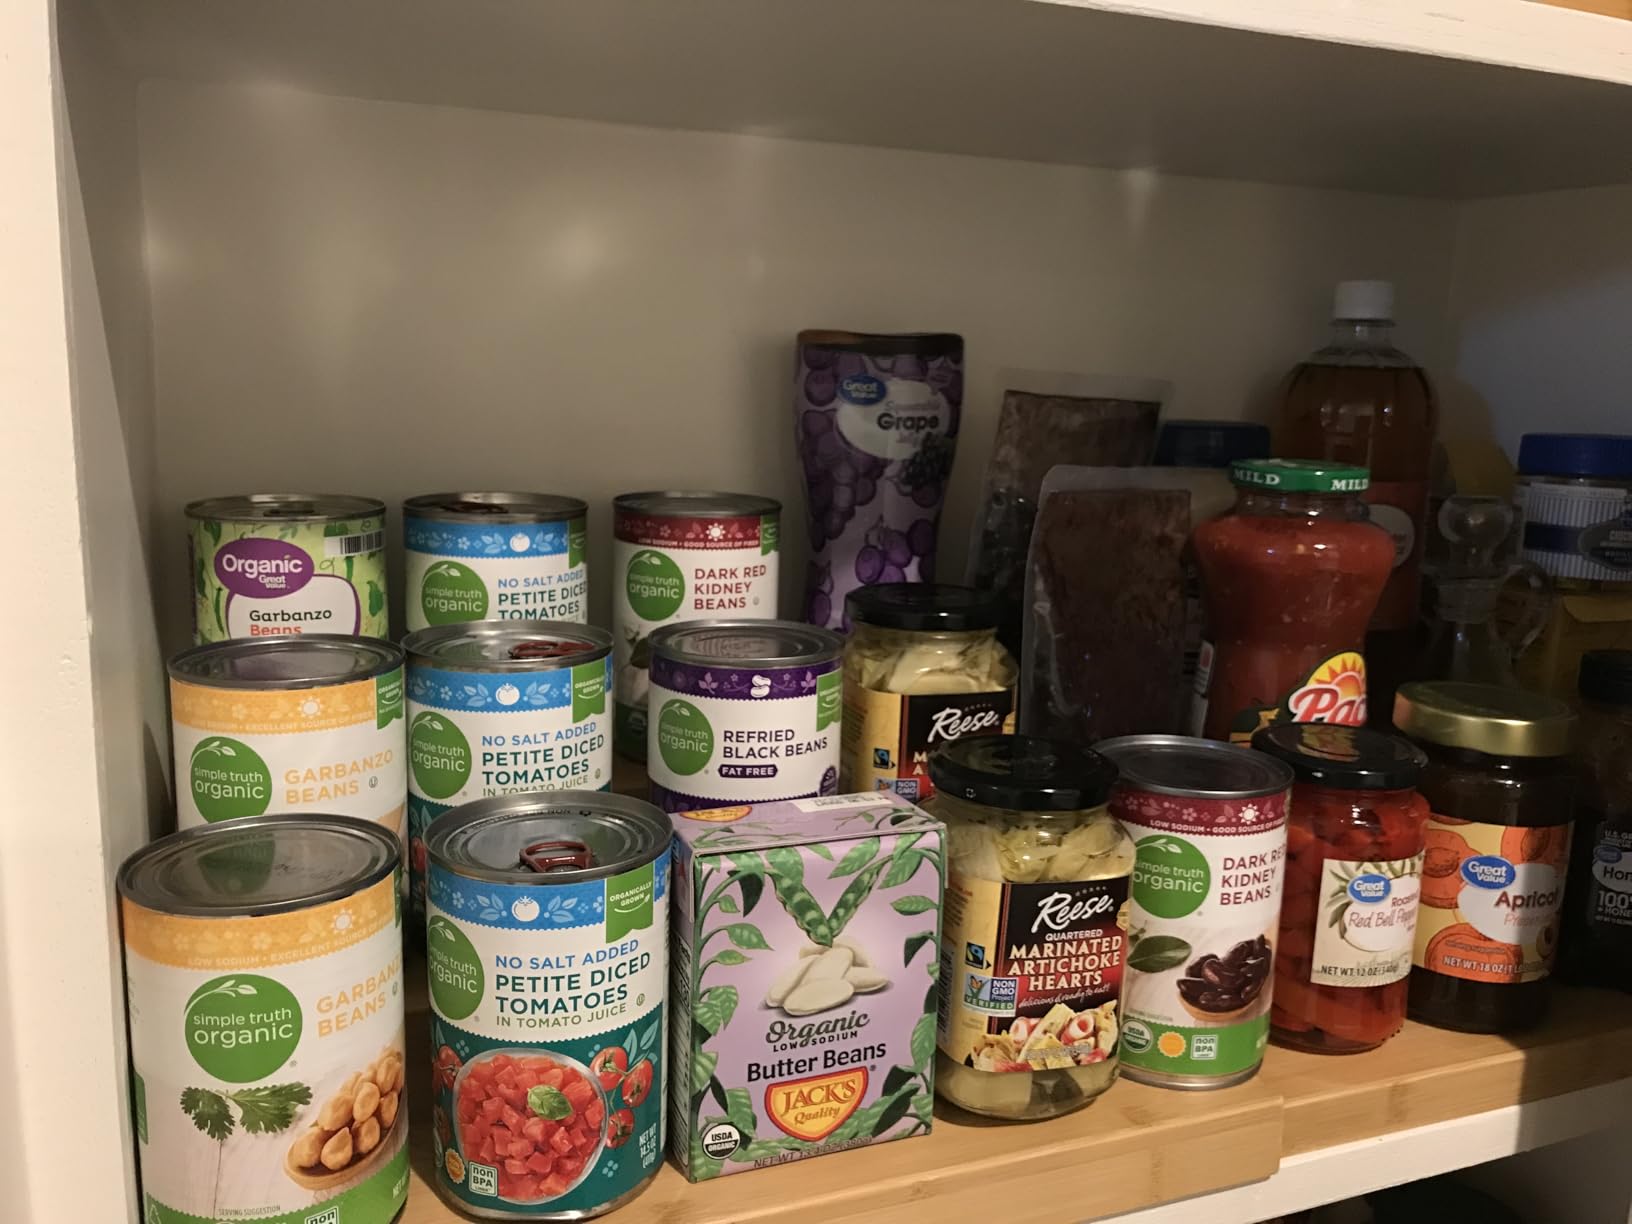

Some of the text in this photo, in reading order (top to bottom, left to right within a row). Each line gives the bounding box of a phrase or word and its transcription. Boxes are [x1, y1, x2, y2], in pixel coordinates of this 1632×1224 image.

[877, 412, 939, 434] Grape
[1234, 469, 1280, 485] MILD
[1331, 478, 1369, 491] MILD
[222, 554, 303, 578] Organic
[695, 564, 767, 580] DARK RED
[498, 578, 519, 588] NO
[524, 576, 553, 587] SALT
[656, 575, 680, 586] truth
[694, 581, 752, 595] KIDNEY
[455, 588, 482, 599] truth
[498, 590, 557, 606] PETITE
[629, 583, 680, 599] organic
[425, 596, 483, 613] organic
[498, 600, 580, 620] TOMATOES
[694, 596, 747, 611] BEANS
[249, 608, 332, 622] Garbanzo
[250, 624, 302, 636] Beans
[685, 728, 708, 739] truth
[927, 706, 998, 743] Reese
[482, 722, 596, 746] NO SALT ADDED
[661, 732, 708, 753] organic
[723, 729, 795, 743] REFRIED
[437, 744, 465, 757] truth
[482, 734, 605, 767] PETITE DICED
[723, 737, 828, 759] BLACK BEANS
[284, 749, 393, 785] GARBANZO
[413, 749, 465, 773] organic
[194, 766, 263, 783] simple truth
[482, 759, 590, 785] TOMATOES
[722, 766, 774, 775] FAT FREE
[195, 781, 264, 799] organic
[285, 780, 359, 804] BEANS
[483, 787, 497, 797] IN
[559, 775, 589, 791] JUICE
[896, 787, 917, 795] GMO
[1150, 819, 1170, 827] LOW
[1171, 822, 1205, 833] SODIUM
[1212, 826, 1236, 834] GOOD
[1238, 824, 1265, 833] SOURCE
[1223, 852, 1267, 870] DARK
[1468, 861, 1507, 876] Great
[1132, 870, 1204, 893] organic
[1173, 867, 1204, 878] truth
[1221, 867, 1277, 888] KIDNEY
[1476, 873, 1506, 883] Value
[609, 881, 652, 902] ORGANICALLY
[1354, 880, 1385, 891] Great
[620, 892, 645, 906] GROWN
[1220, 885, 1271, 905] BEANS
[1031, 891, 1113, 933] Reese
[1348, 909, 1394, 928] Red Bell
[1045, 929, 1103, 942] QUARTERED
[495, 939, 639, 970] NO SALT ADDED
[1008, 936, 1122, 959] MARINATED
[450, 957, 477, 976] truth
[495, 952, 651, 993] PETITE DICED
[1007, 951, 1121, 976] ARTICHOKE
[1320, 965, 1338, 975] NET
[1356, 967, 1366, 976] 12
[1443, 955, 1461, 967] NET
[1463, 959, 1477, 970] WT
[1480, 962, 1490, 972] 18
[1492, 964, 1504, 973] OZ
[430, 955, 477, 993] organic
[1028, 970, 1103, 992] HEARTS
[992, 979, 1015, 988] NON
[992, 987, 1015, 996] GMO
[495, 984, 629, 1015] TOMATOES
[966, 995, 1014, 1010] VERIFIED
[193, 1007, 292, 1028] simple truth
[318, 992, 387, 1038] BEANS
[496, 1003, 627, 1028] IN TOMATO JUICE
[193, 1023, 294, 1048] organic
[766, 1010, 870, 1047] Organic
[773, 1030, 858, 1052] LOW SODIUM
[747, 1042, 887, 1082] Butter Beans
[780, 1079, 856, 1117] JACK'S
[794, 1105, 841, 1125] Quality
[711, 1132, 733, 1142] USDA
[707, 1141, 737, 1152] ORGANIC
[753, 1157, 775, 1168] NET
[777, 1151, 795, 1163] WT
[472, 1166, 493, 1178] non
[472, 1176, 493, 1188] BPA
[309, 1211, 335, 1224] non
